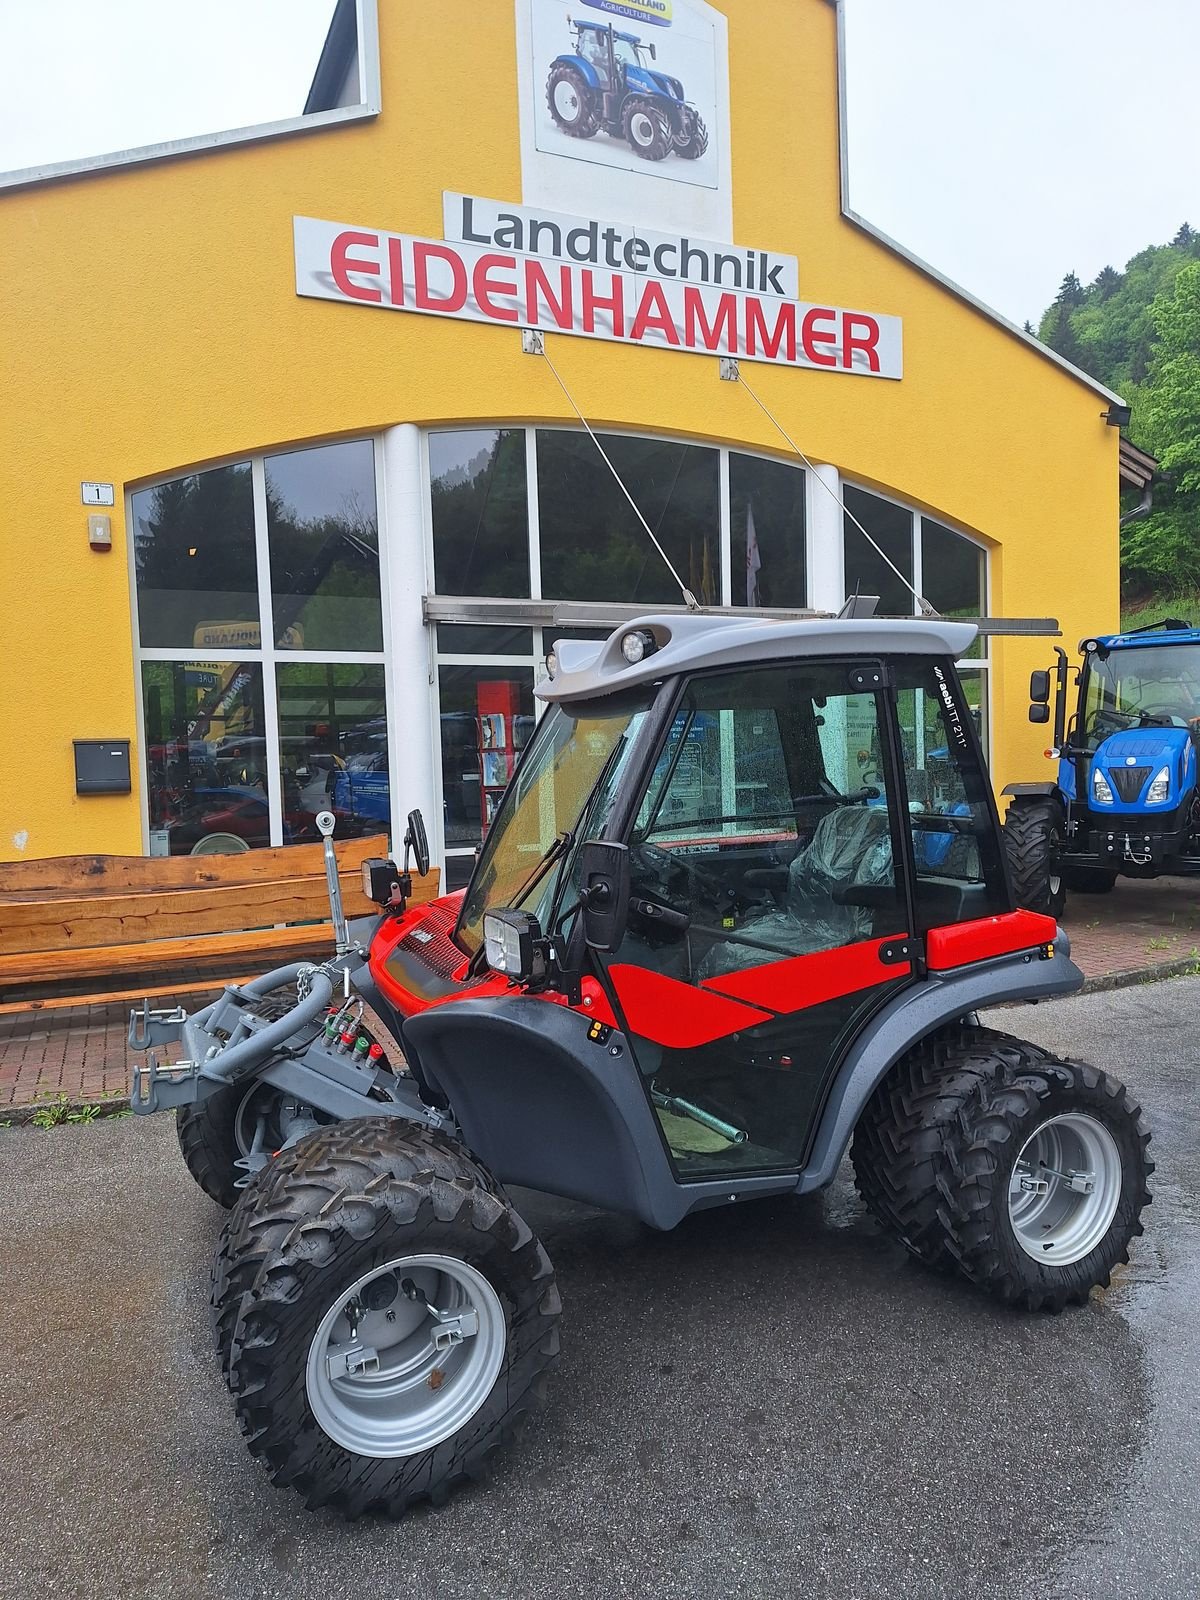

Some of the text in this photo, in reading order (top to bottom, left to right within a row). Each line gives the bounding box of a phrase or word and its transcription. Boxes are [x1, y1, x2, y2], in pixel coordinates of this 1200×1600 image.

[600, 1, 652, 20] AGRICULTURE
[461, 197, 785, 294] Landtechnik
[330, 231, 881, 373] EIDENHAMMER
[95, 487, 100, 500] 1
[940, 683, 955, 709] aebi
[949, 709, 960, 723] TT
